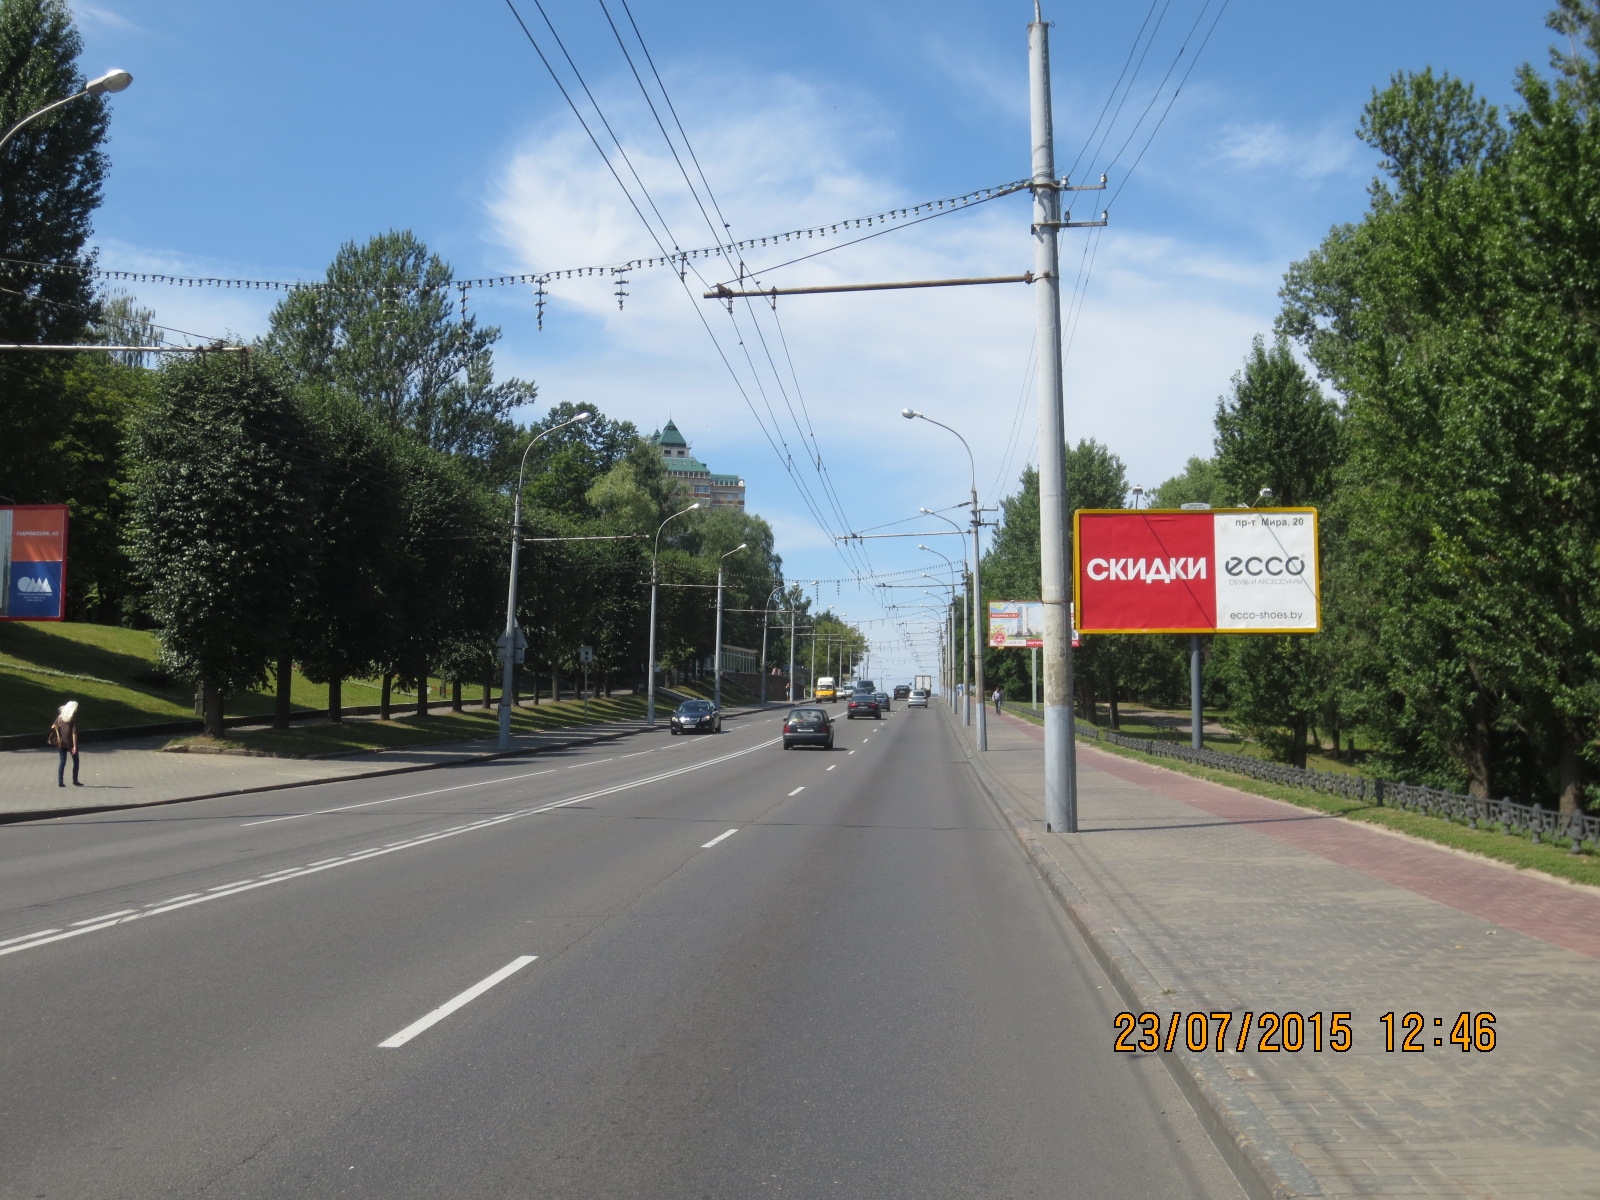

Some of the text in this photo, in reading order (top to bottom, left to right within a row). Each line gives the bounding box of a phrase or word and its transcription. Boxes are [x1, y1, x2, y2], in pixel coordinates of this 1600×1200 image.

[1235, 517, 1304, 528] пр-т Мира, 20
[1086, 557, 1207, 584] СКИДКИ
[1225, 556, 1305, 577] ecco
[1229, 610, 1303, 620] ecco-shoes.by
